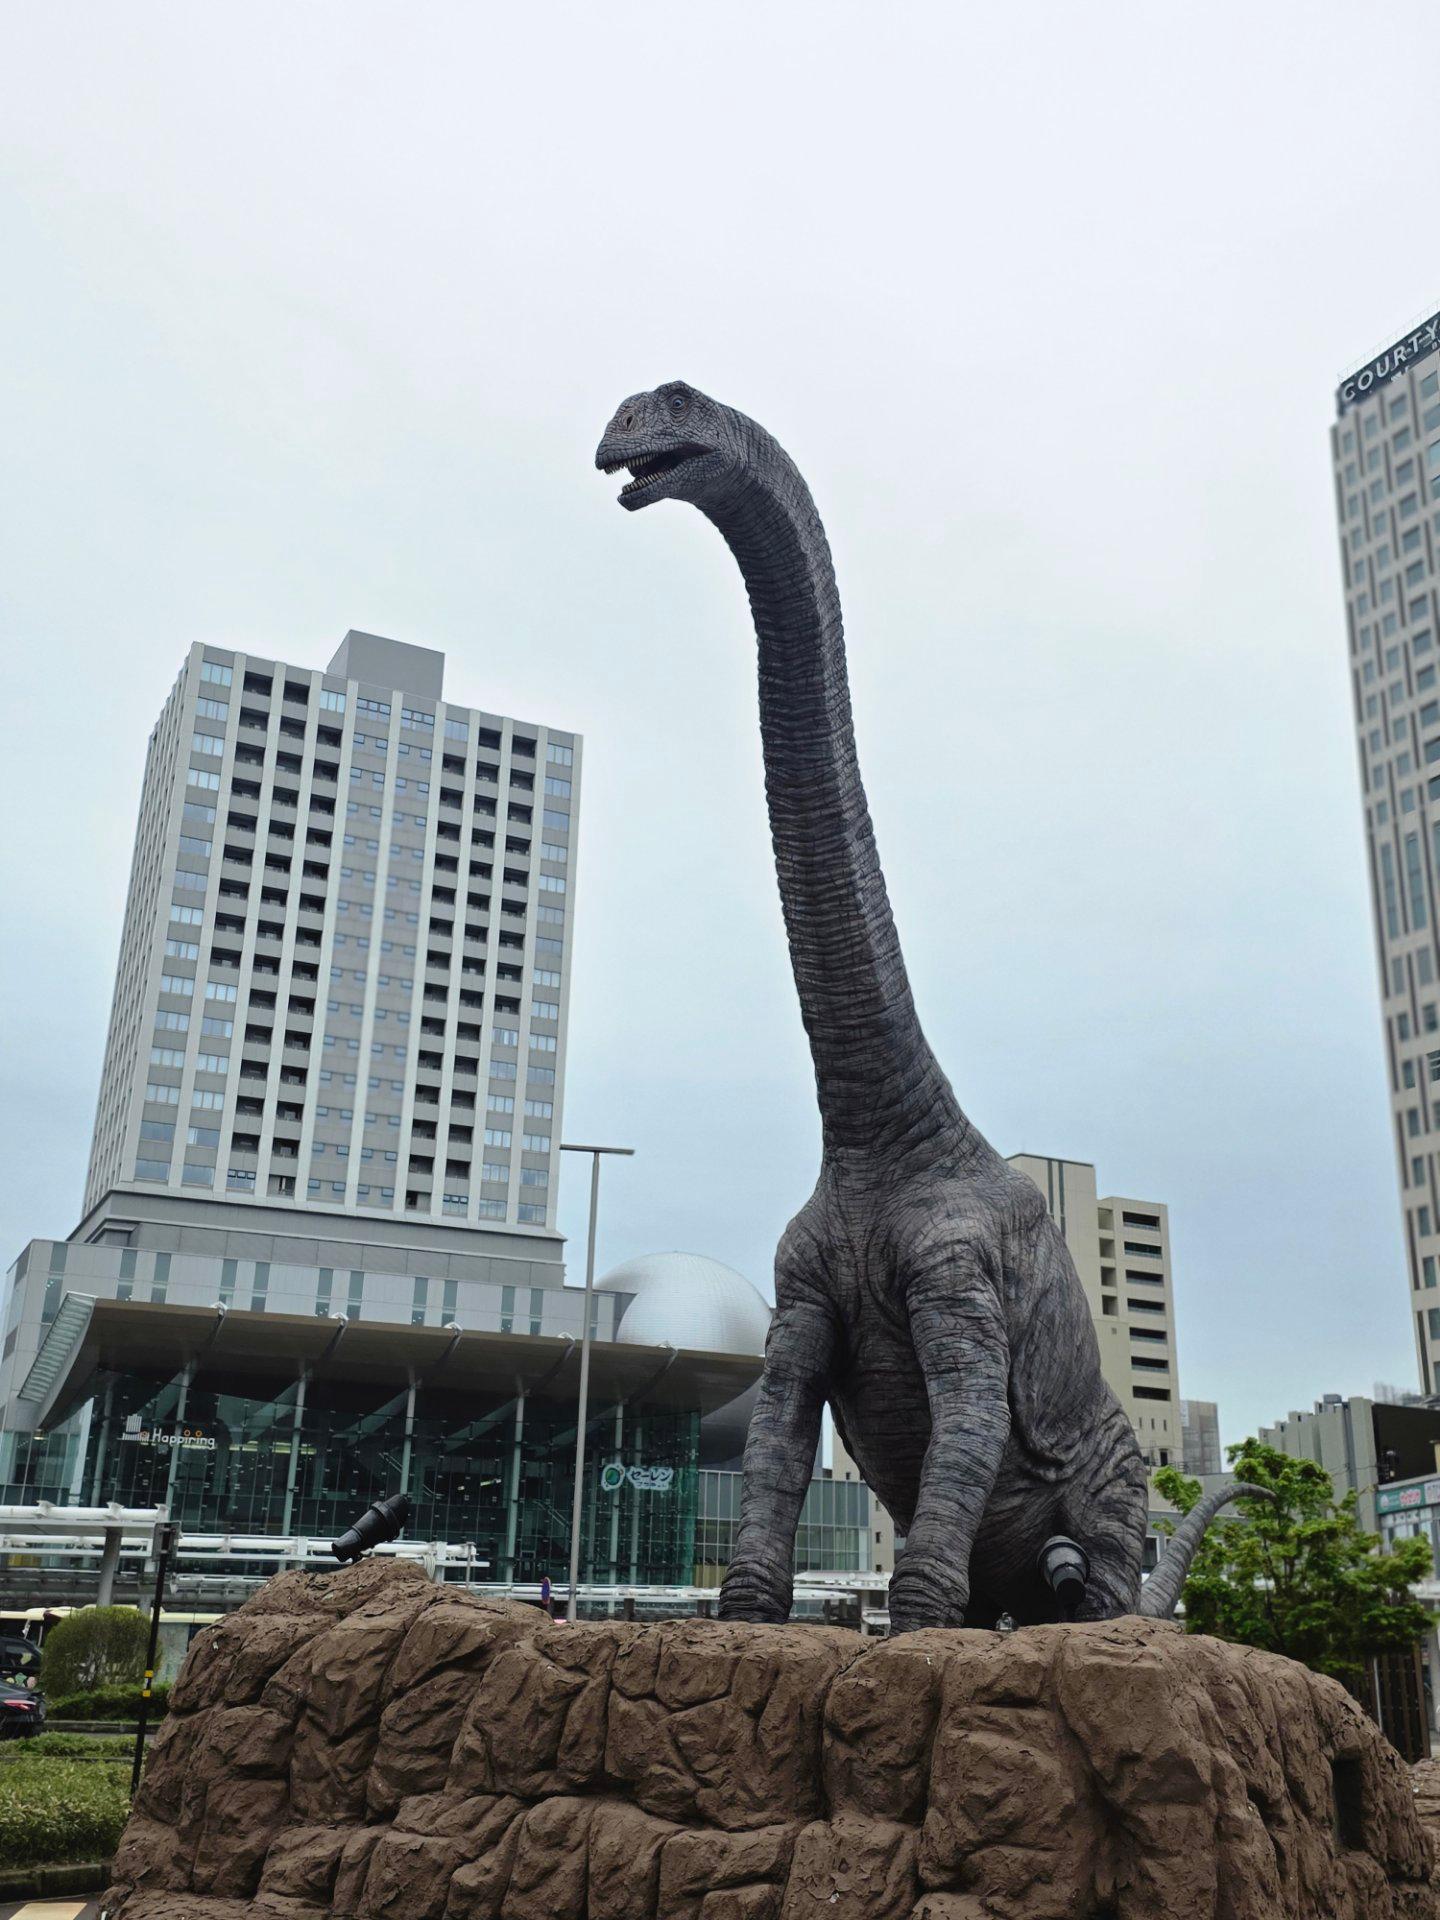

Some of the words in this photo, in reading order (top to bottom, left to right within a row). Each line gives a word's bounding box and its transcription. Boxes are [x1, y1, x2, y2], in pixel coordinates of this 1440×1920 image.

[153, 1428, 215, 1450] Happiring
[631, 1470, 671, 1481] セーレン
